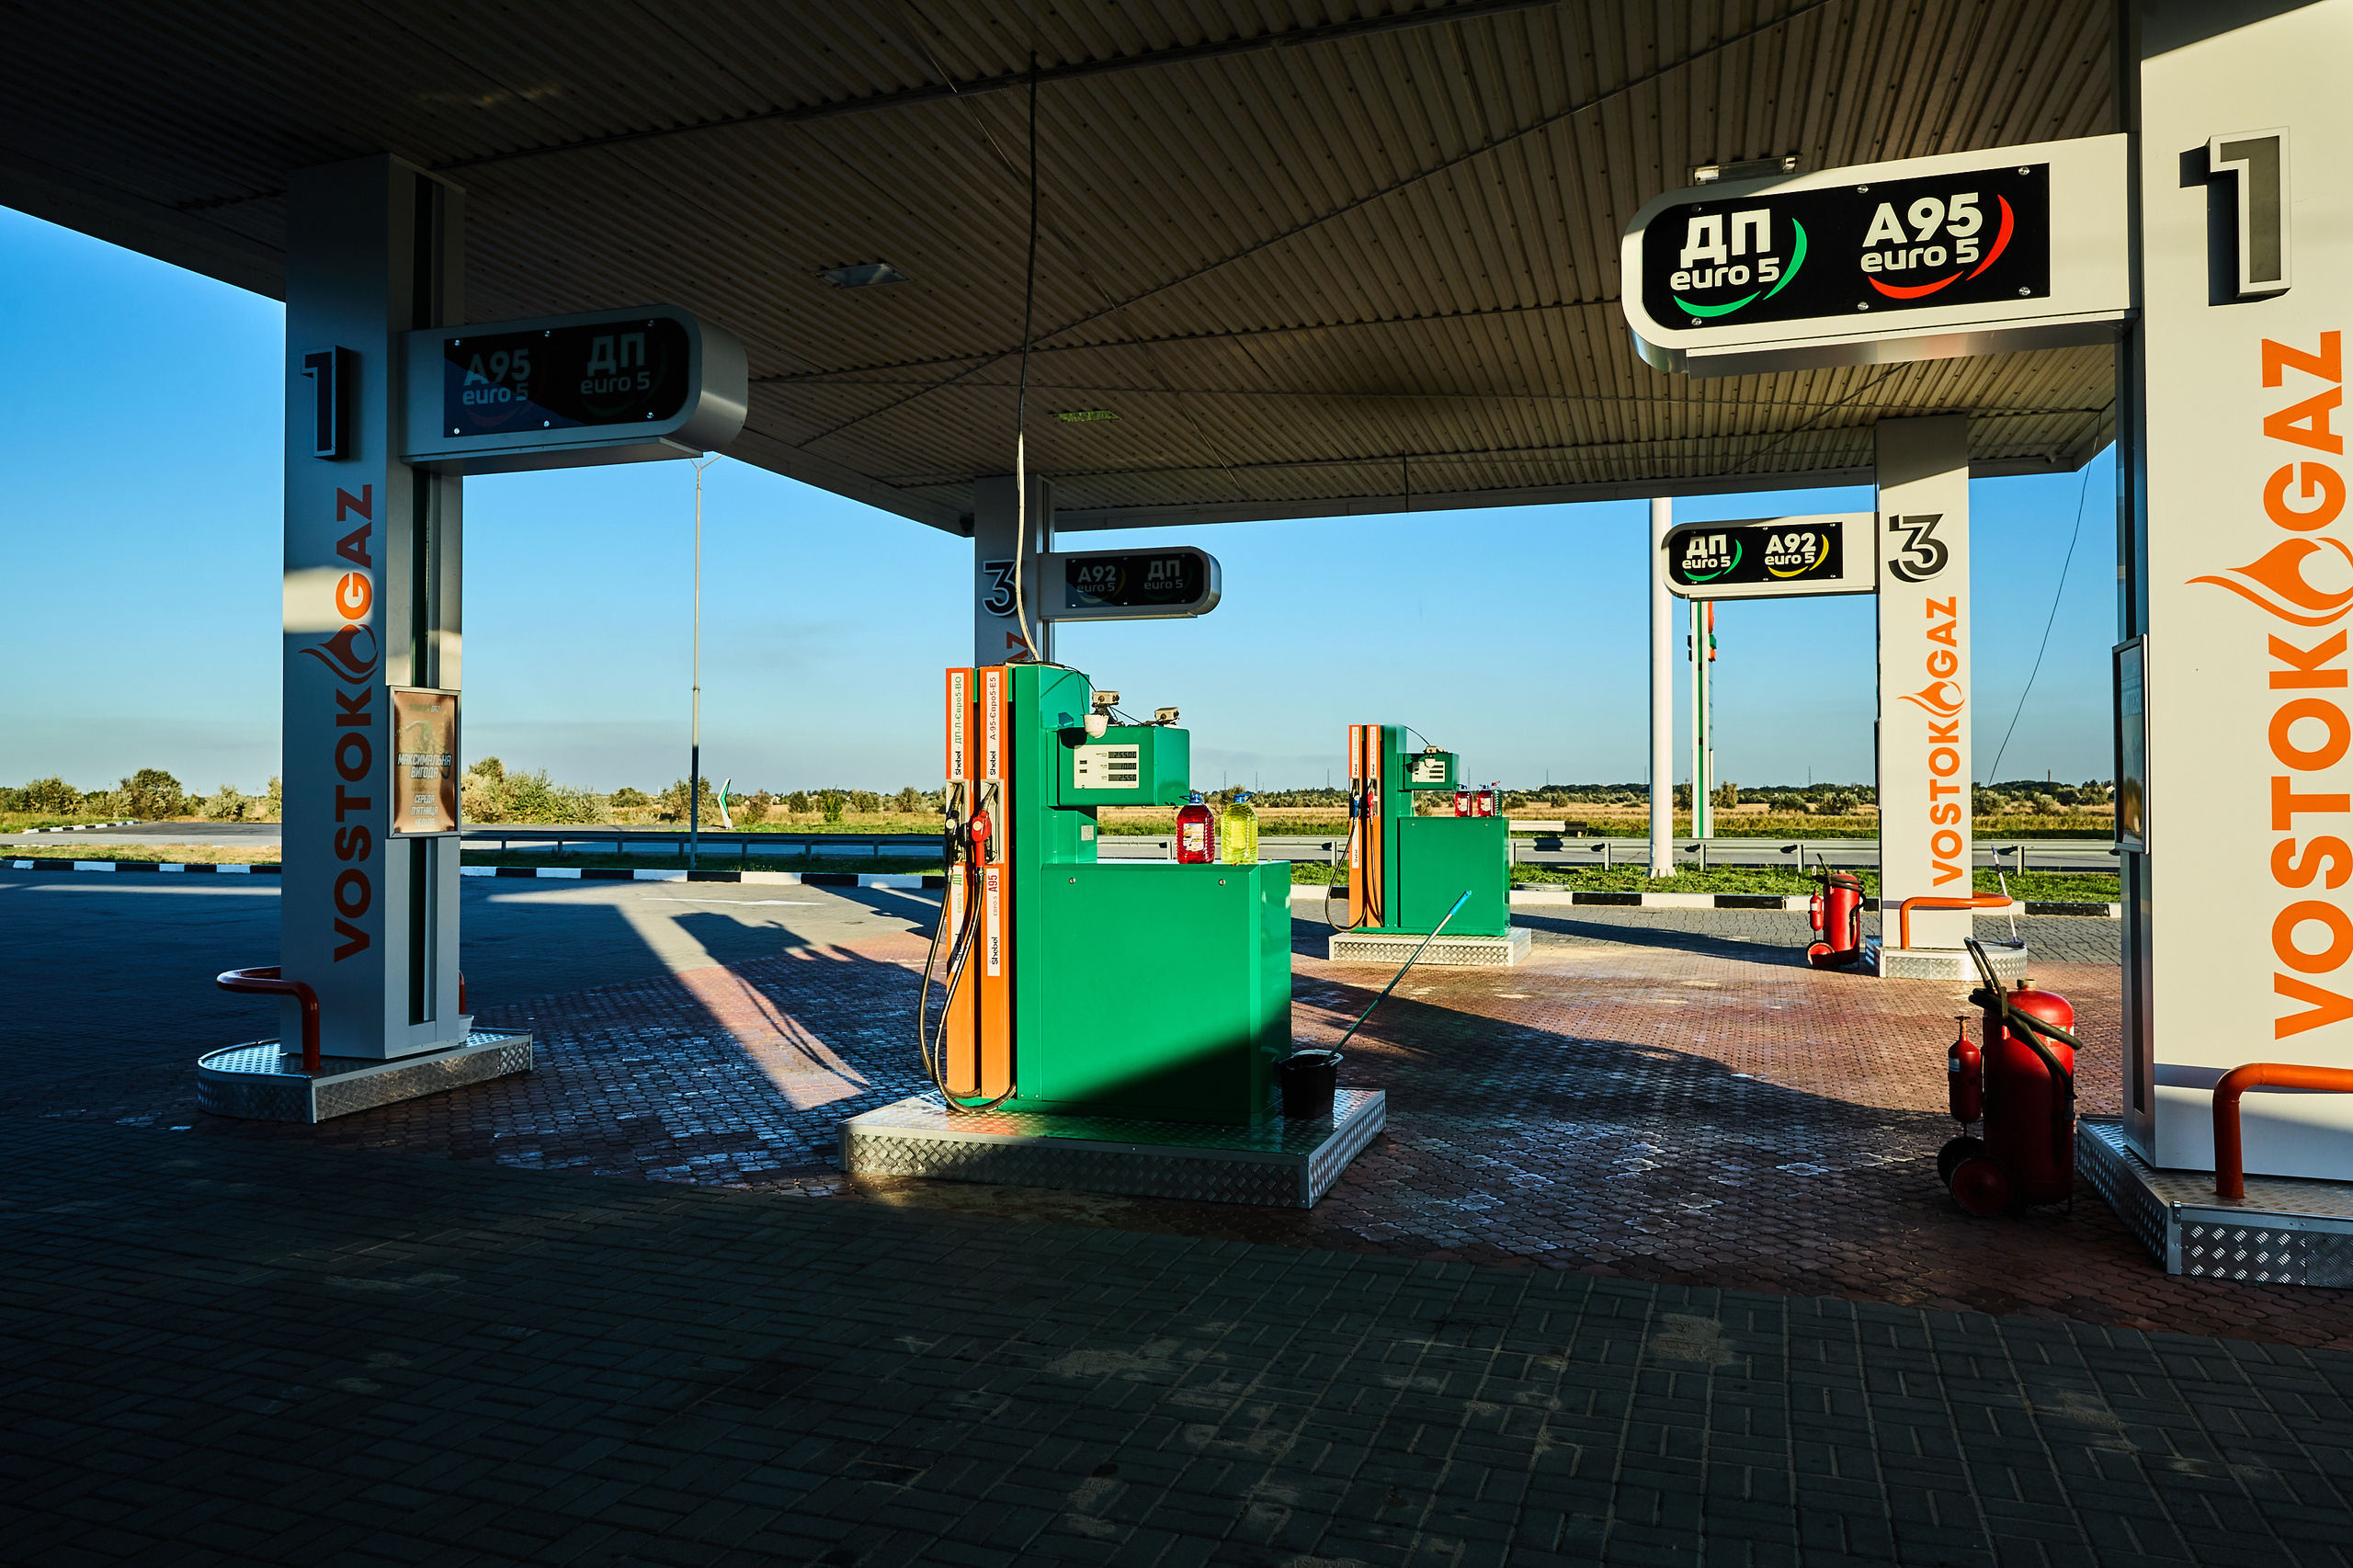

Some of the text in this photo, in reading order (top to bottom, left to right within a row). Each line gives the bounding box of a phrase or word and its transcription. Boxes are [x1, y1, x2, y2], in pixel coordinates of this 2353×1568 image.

[2206, 126, 2291, 301] 1
[1680, 209, 1771, 268] ДП
[1860, 237, 1980, 274] euro 5
[1670, 256, 1780, 291] euro 5
[586, 332, 645, 377] ДП
[462, 382, 529, 405] euro 5
[580, 371, 651, 394] euro 5
[301, 346, 342, 458] 1
[1686, 534, 1727, 560] ДП
[1764, 551, 1815, 566] euro 5
[1892, 511, 1950, 582] 3
[1147, 560, 1180, 581] ДП
[1681, 555, 1731, 569] euro 5
[983, 559, 1020, 617] 3
[1076, 582, 1115, 593] euro 5
[1143, 579, 1184, 590] euro 5
[397, 753, 453, 767] МАКСИМАЛЬНА
[411, 767, 439, 780] ВИГОДА
